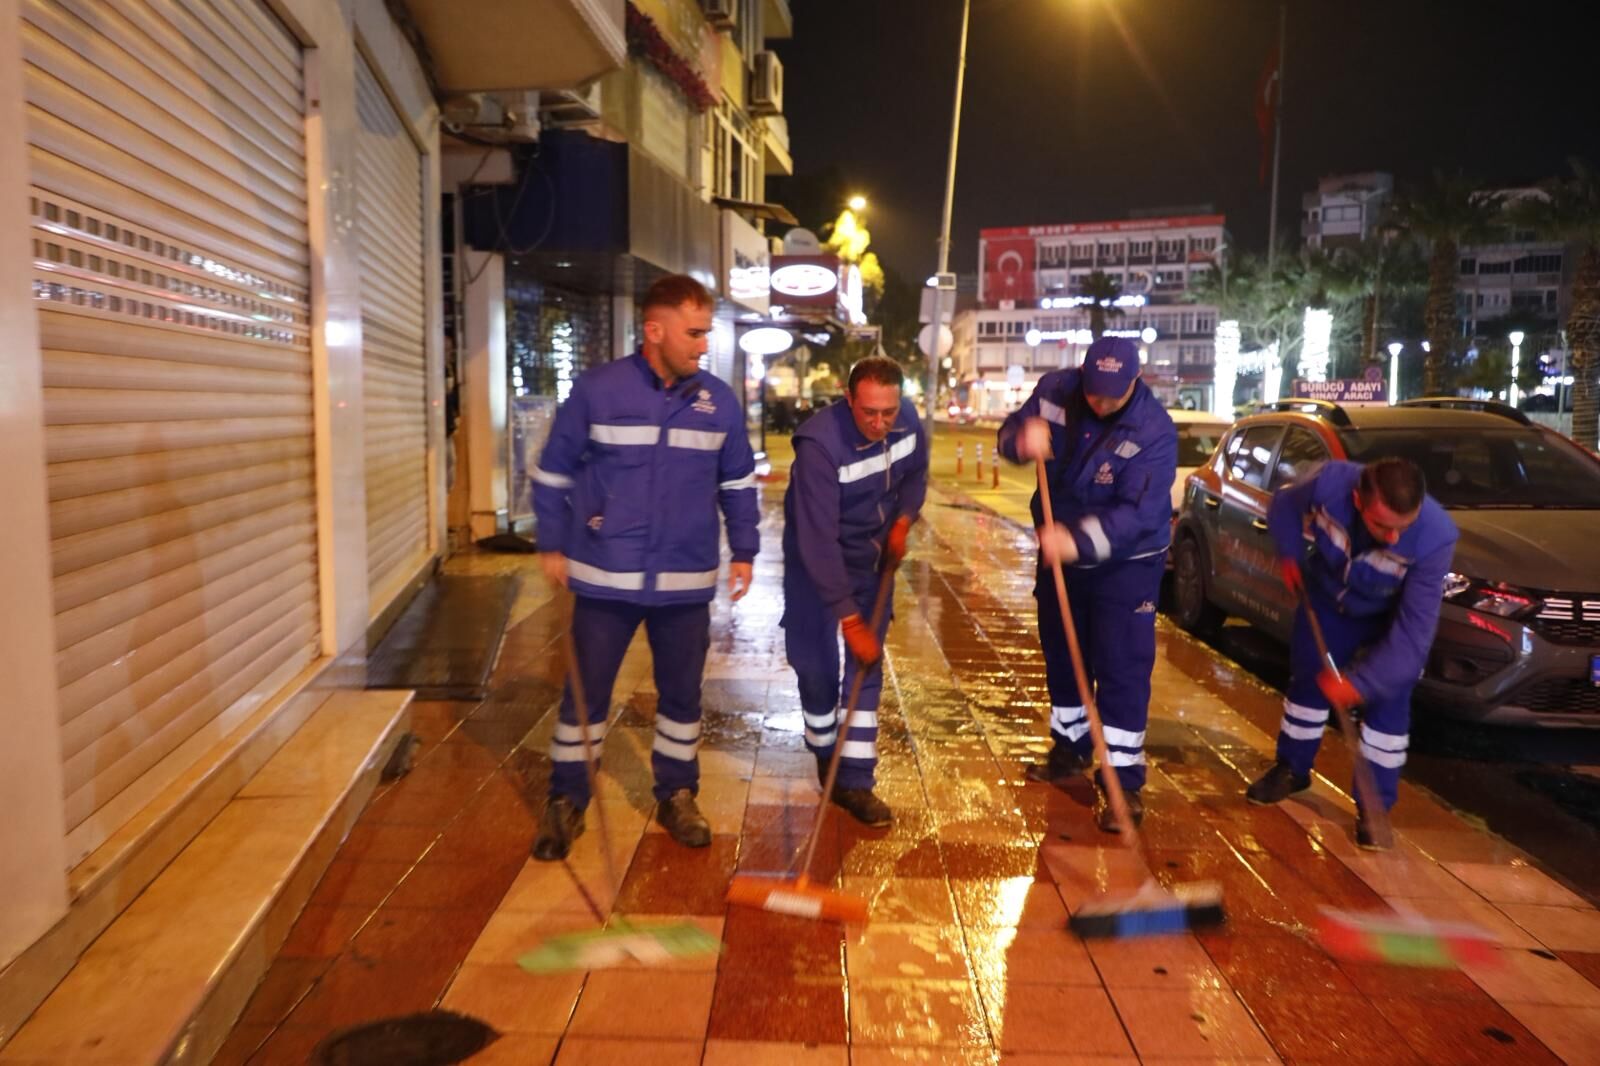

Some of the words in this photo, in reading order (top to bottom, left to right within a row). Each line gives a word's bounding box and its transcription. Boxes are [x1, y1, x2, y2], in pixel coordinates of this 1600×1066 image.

[1350, 382, 1381, 392] ADAYI
[1311, 392, 1339, 400] SINAV
[1344, 392, 1373, 400] ARACI
